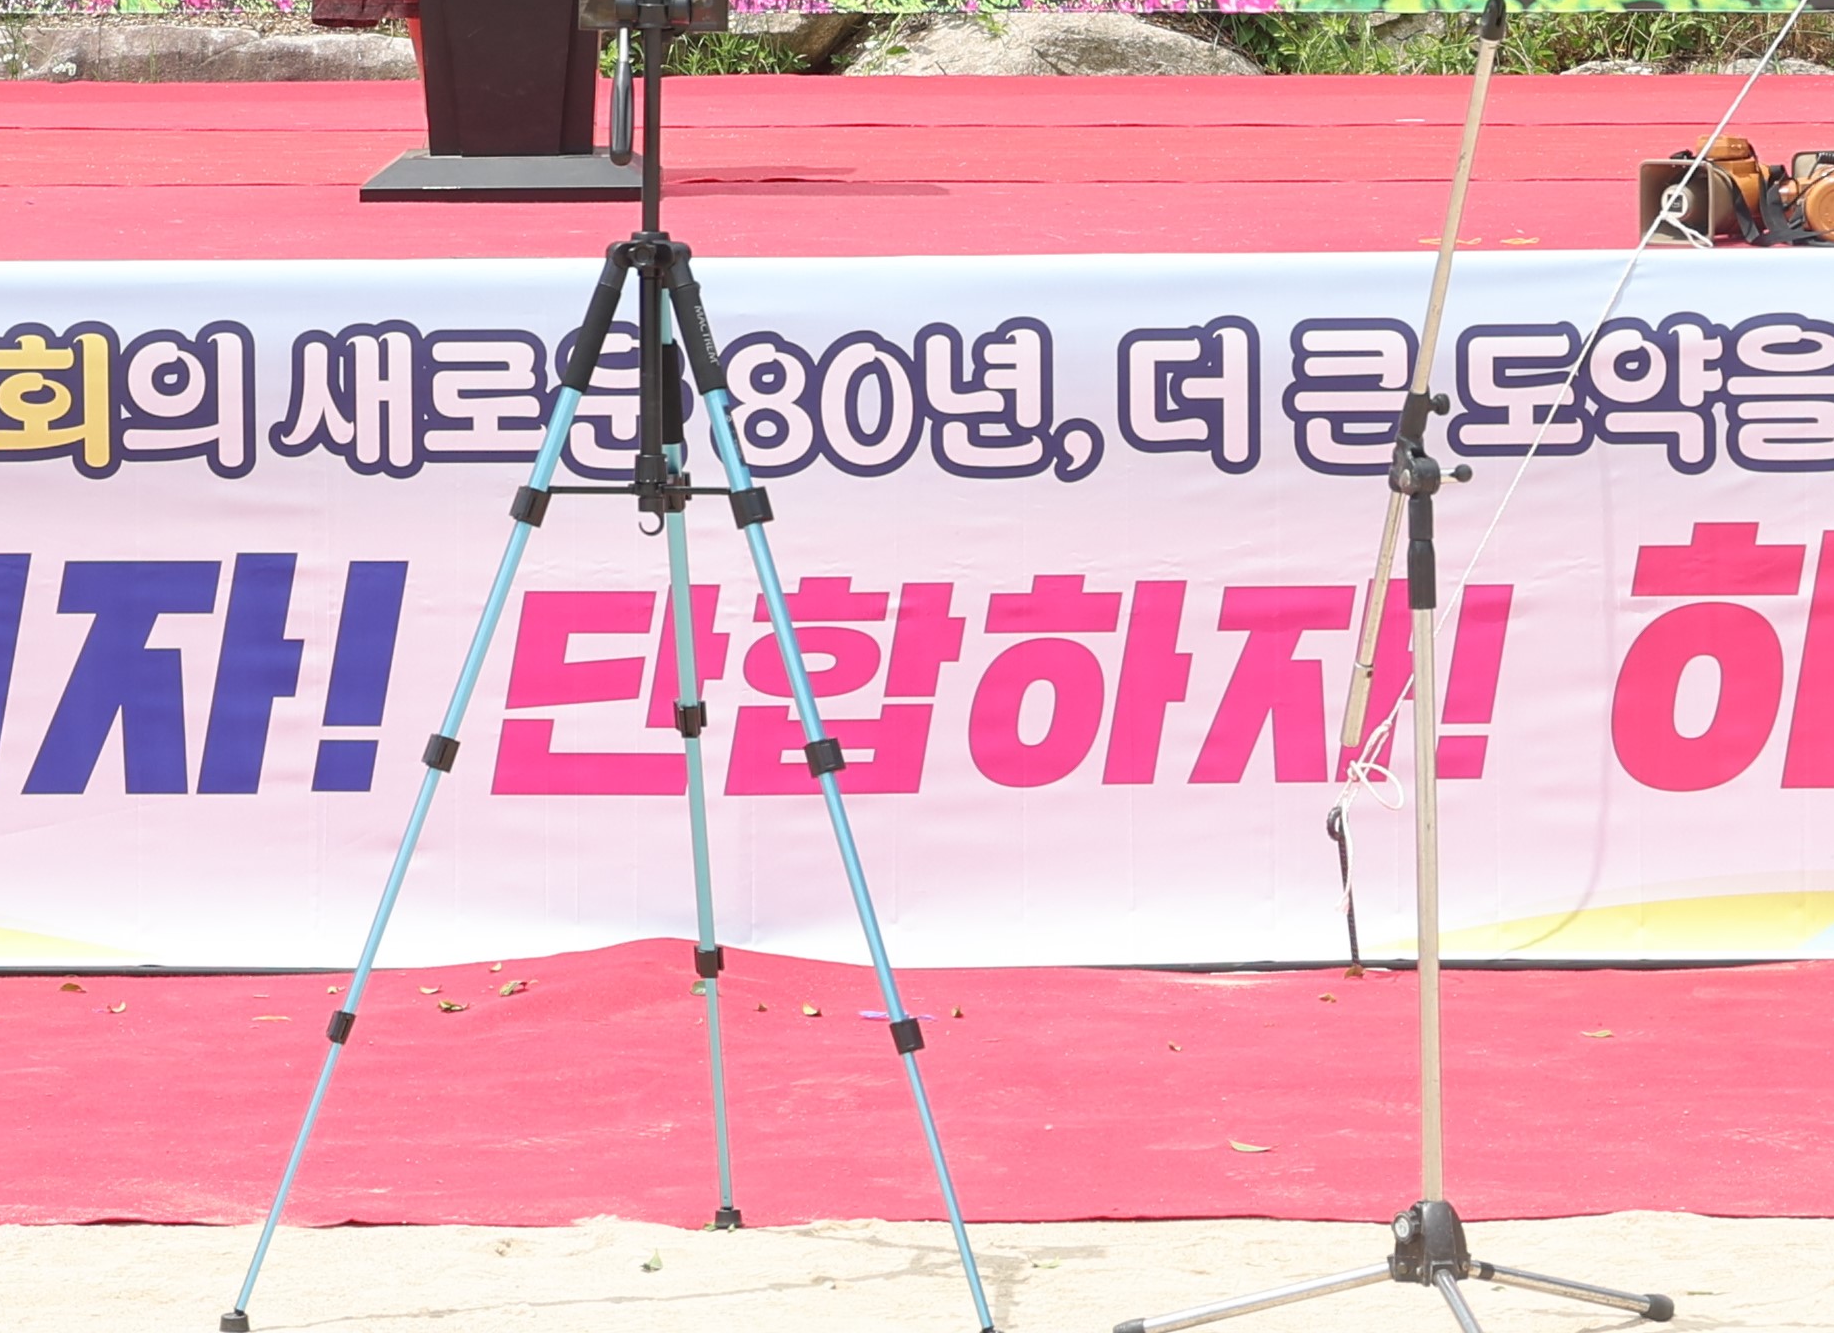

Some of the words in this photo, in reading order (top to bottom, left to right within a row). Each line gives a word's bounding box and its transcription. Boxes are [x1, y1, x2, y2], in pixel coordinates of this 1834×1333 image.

[726, 321, 1094, 475] 80년,
[1128, 328, 1254, 464] 더
[1286, 327, 1418, 469] 큰
[490, 574, 1514, 796] 단합하자!
